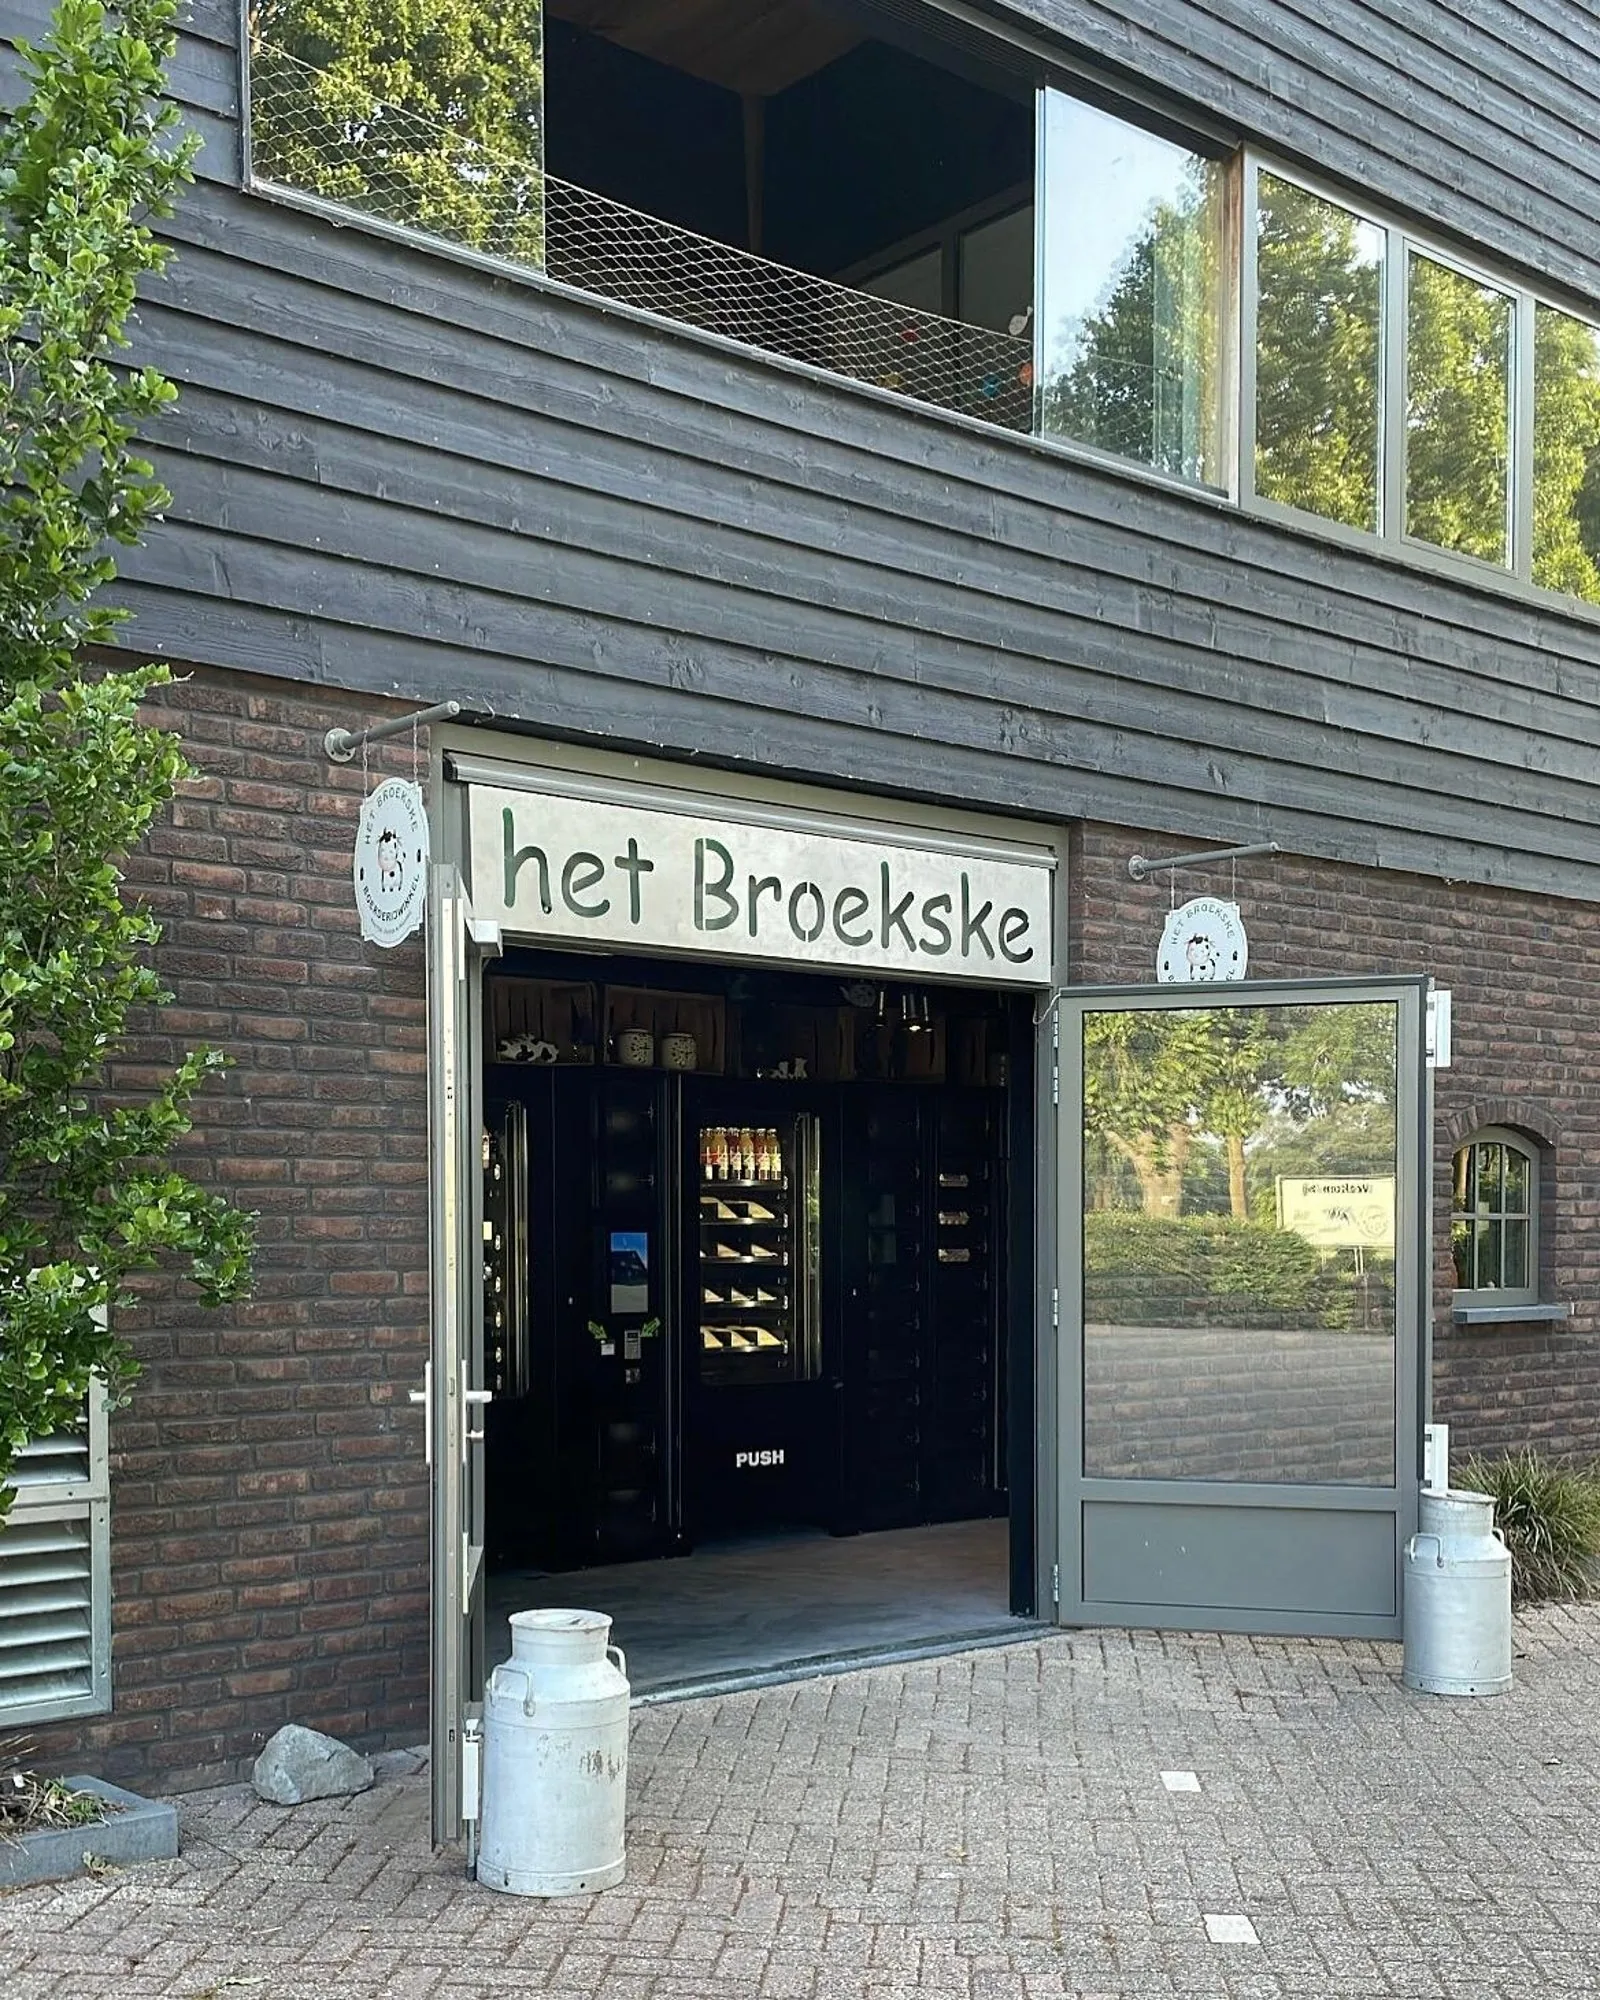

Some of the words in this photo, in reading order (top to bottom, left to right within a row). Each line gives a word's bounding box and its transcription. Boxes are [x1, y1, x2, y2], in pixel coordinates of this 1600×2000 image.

[365, 811, 376, 845] HET
[376, 786, 419, 833] BROEKSKE
[503, 807, 654, 925] het
[694, 837, 1033, 963] Broekske
[1171, 920, 1184, 945] HET
[1186, 903, 1236, 939] BROEKSKE
[736, 1449, 785, 1468] PUSH
